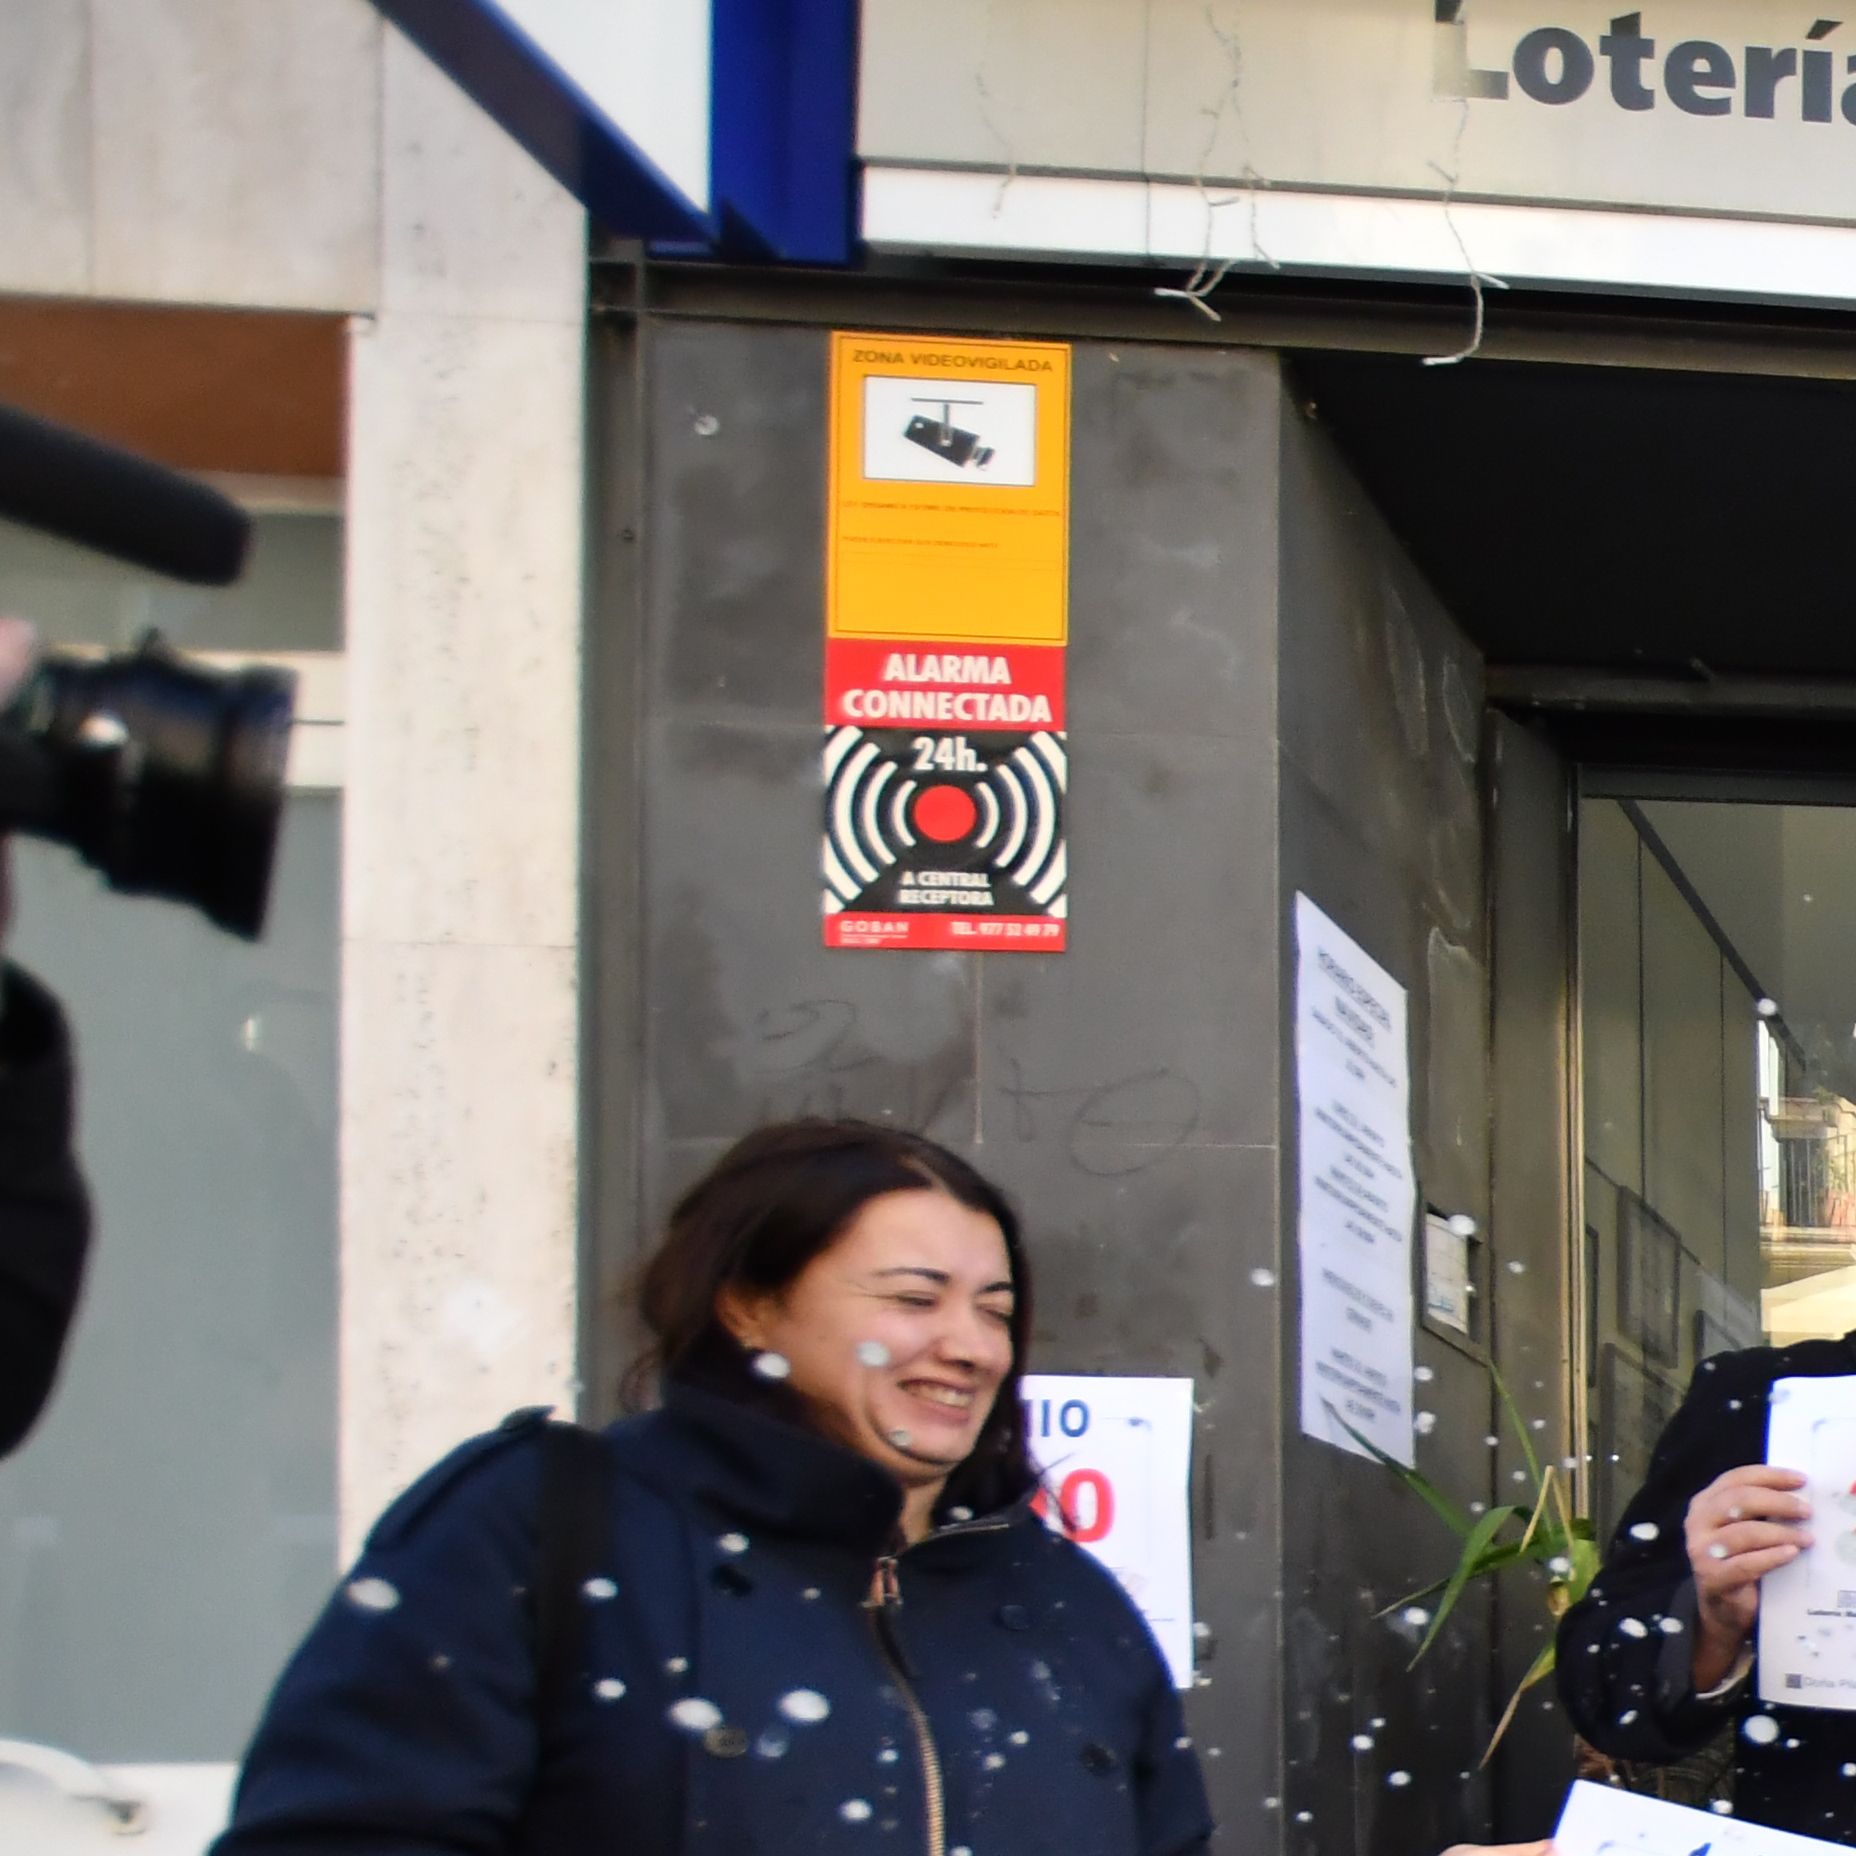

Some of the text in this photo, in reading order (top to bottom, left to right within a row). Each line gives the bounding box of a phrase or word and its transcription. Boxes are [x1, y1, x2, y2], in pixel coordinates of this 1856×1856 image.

[852, 349, 1053, 372] ZONA VIDEOVIGILADA
[883, 653, 1011, 685] ALARMA
[842, 688, 1053, 724] CONNECTADA
[912, 737, 988, 773] 24h.
[902, 871, 991, 888] A CENTRAL
[897, 889, 994, 906] RECEPTORA
